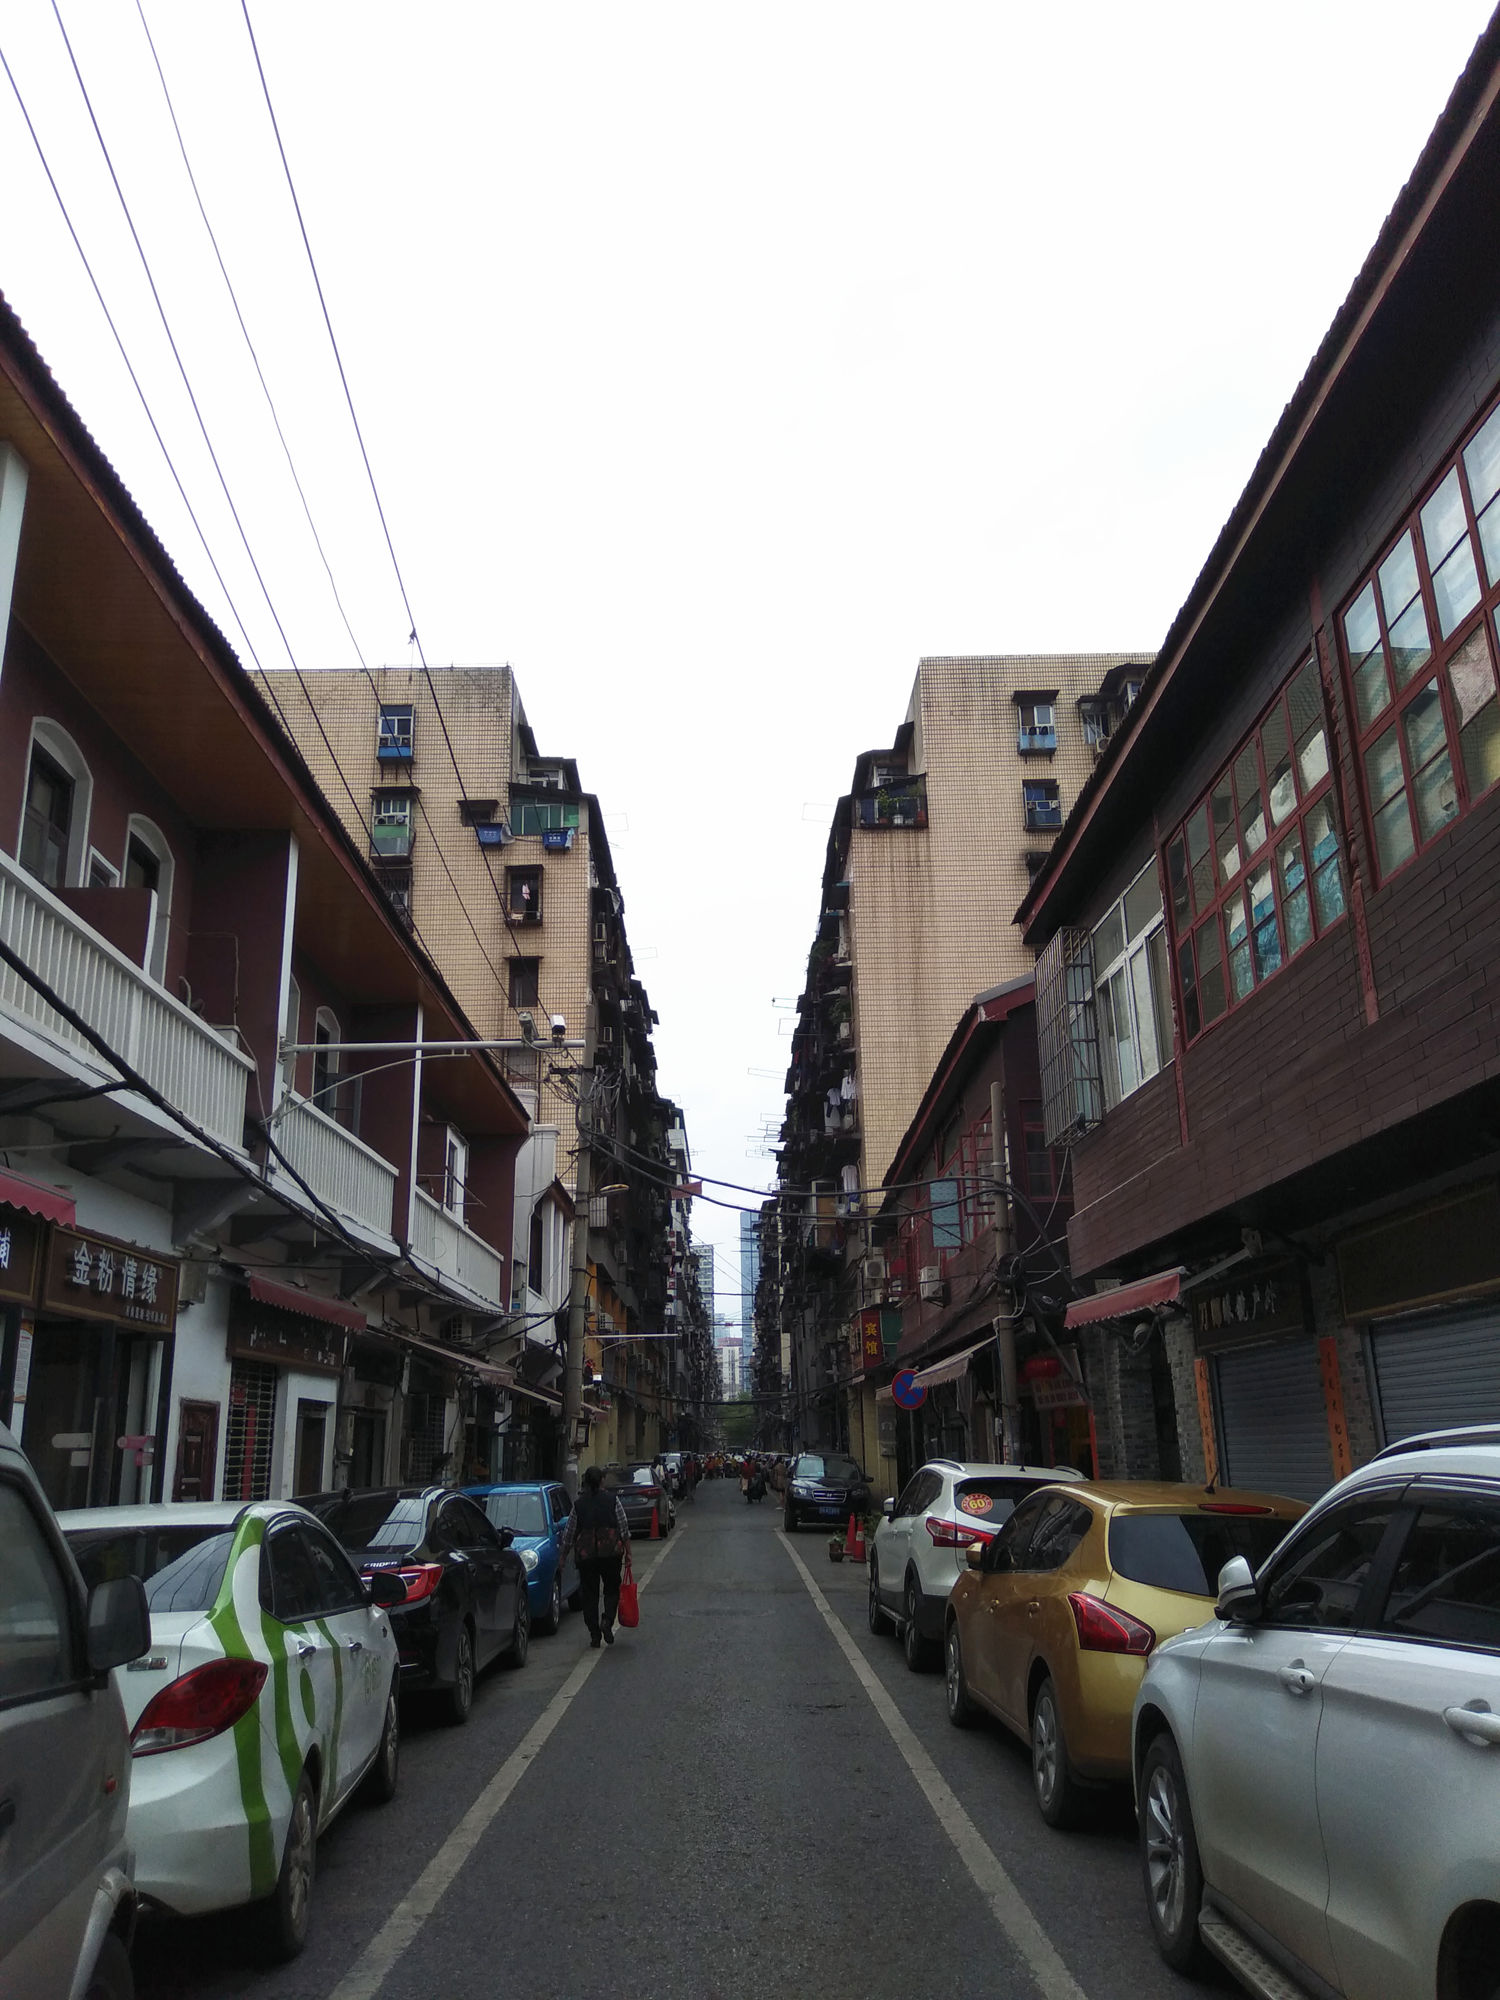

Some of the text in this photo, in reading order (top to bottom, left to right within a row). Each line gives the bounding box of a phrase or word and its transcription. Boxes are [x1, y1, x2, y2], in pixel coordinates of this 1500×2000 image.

[72, 1240, 158, 1304] 金粉情缘
[865, 1322, 878, 1355] 宾馆
[969, 1498, 985, 1509] 60
